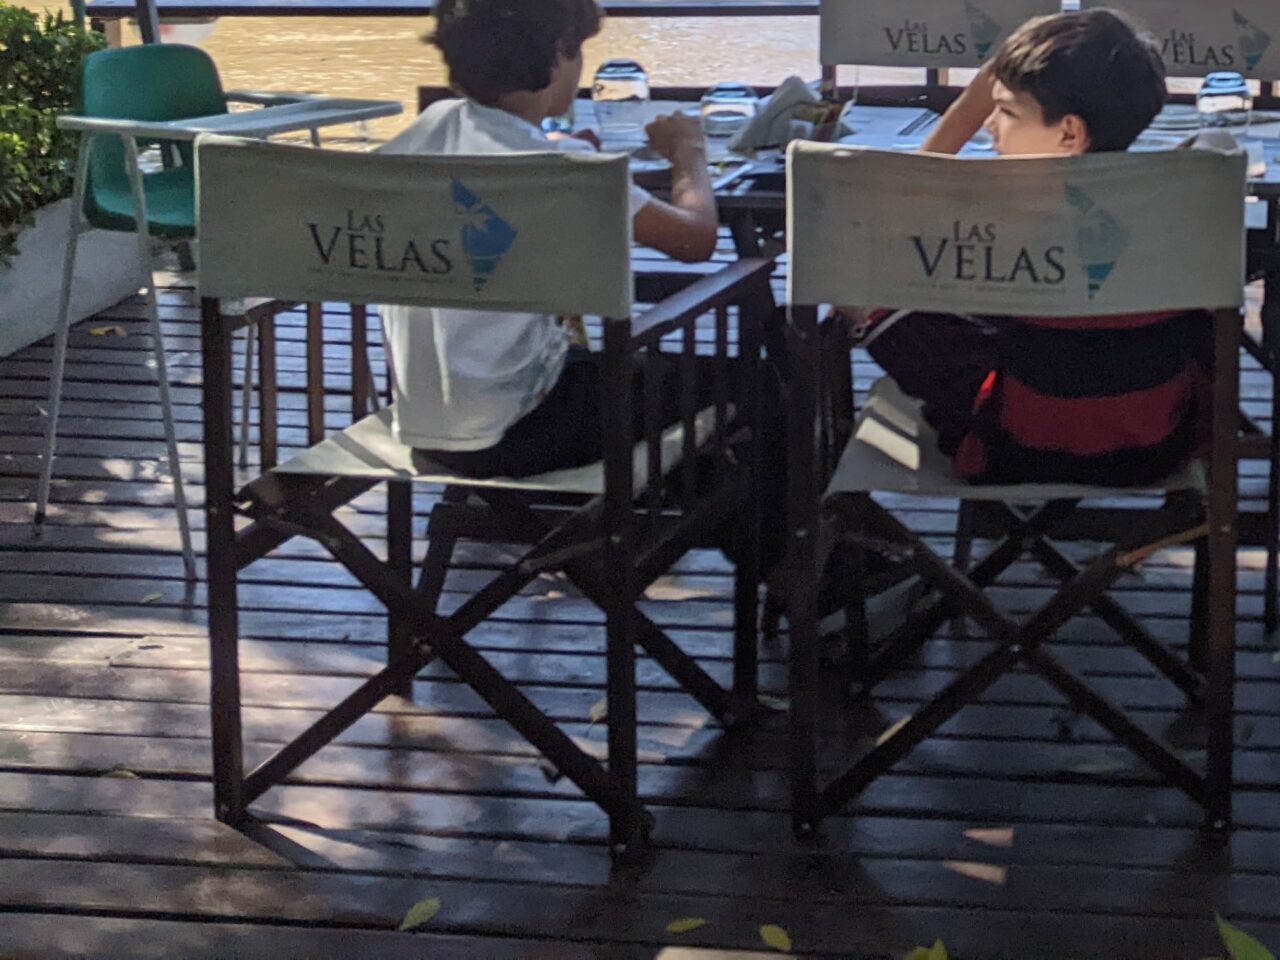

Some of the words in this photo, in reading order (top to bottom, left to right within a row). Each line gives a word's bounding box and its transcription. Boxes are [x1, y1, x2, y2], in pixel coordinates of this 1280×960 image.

[882, 26, 967, 54] VELAS
[346, 209, 385, 233] LAS
[953, 220, 996, 243] LAS
[306, 222, 454, 274] VELAS
[909, 235, 1066, 284] VELAS
